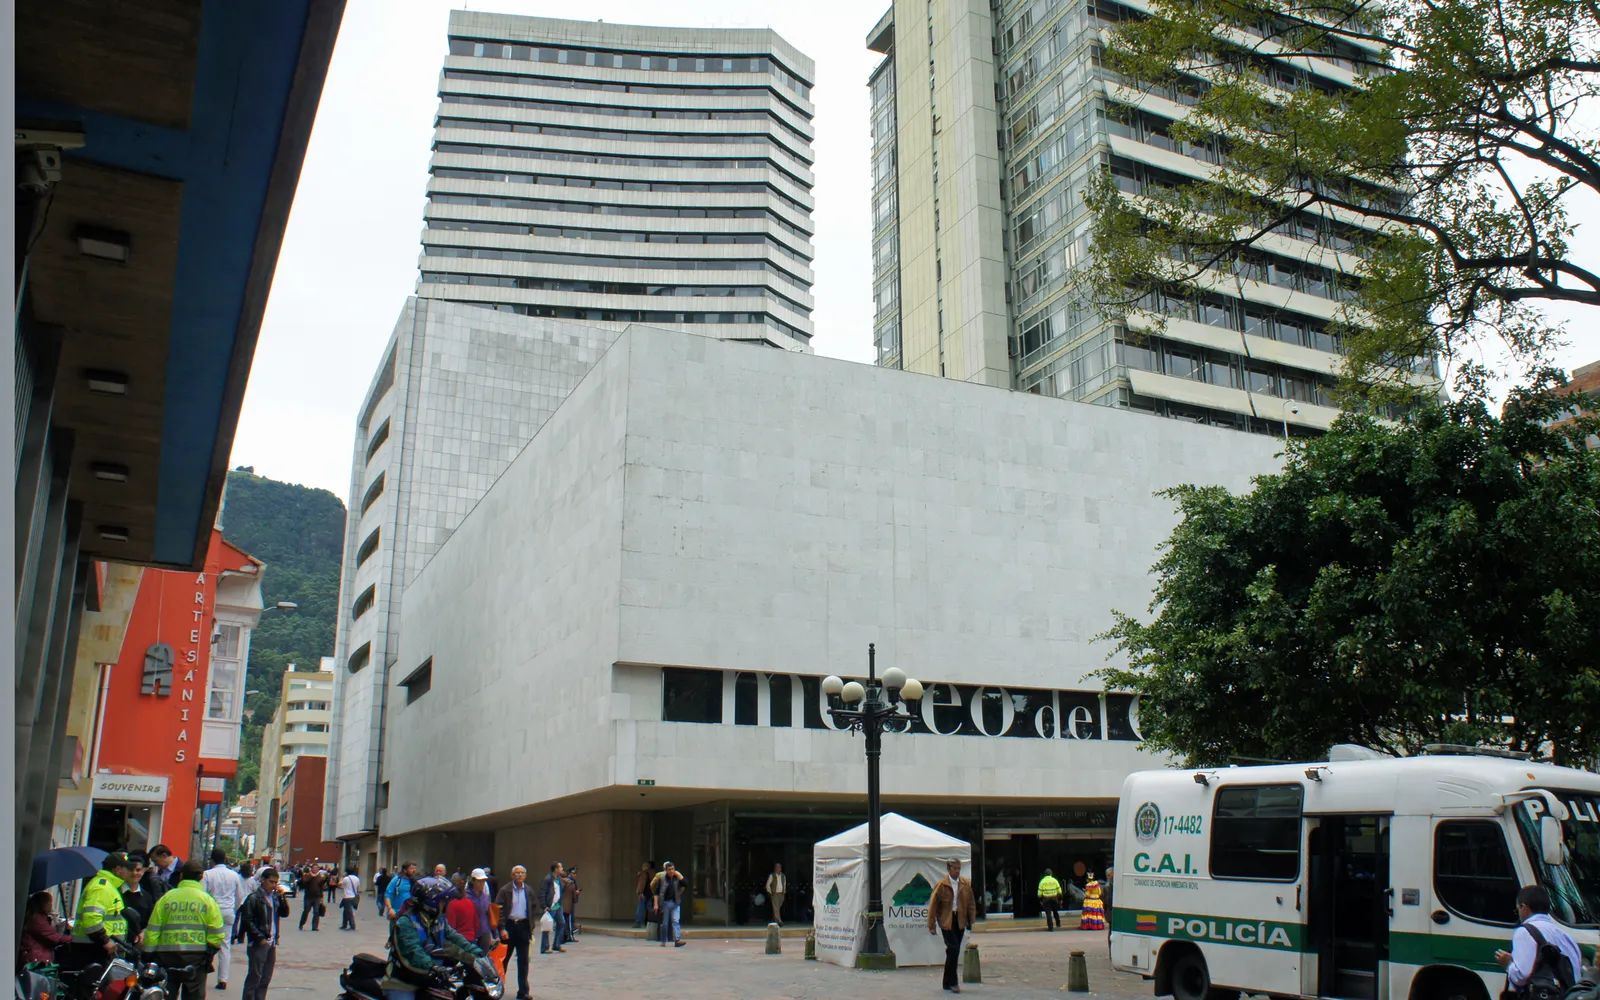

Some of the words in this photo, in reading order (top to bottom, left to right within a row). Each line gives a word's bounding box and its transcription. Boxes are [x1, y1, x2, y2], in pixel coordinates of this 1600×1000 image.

[175, 572, 205, 763] ARTESANIAS
[1034, 688, 1109, 741] del
[100, 782, 161, 793] SOUVENIRS
[1163, 815, 1203, 835] 17-4482
[1133, 852, 1198, 875] C.A.I.
[164, 901, 208, 914] POLICIA
[888, 906, 929, 918] Muse
[1168, 918, 1293, 947] POLICÍA
